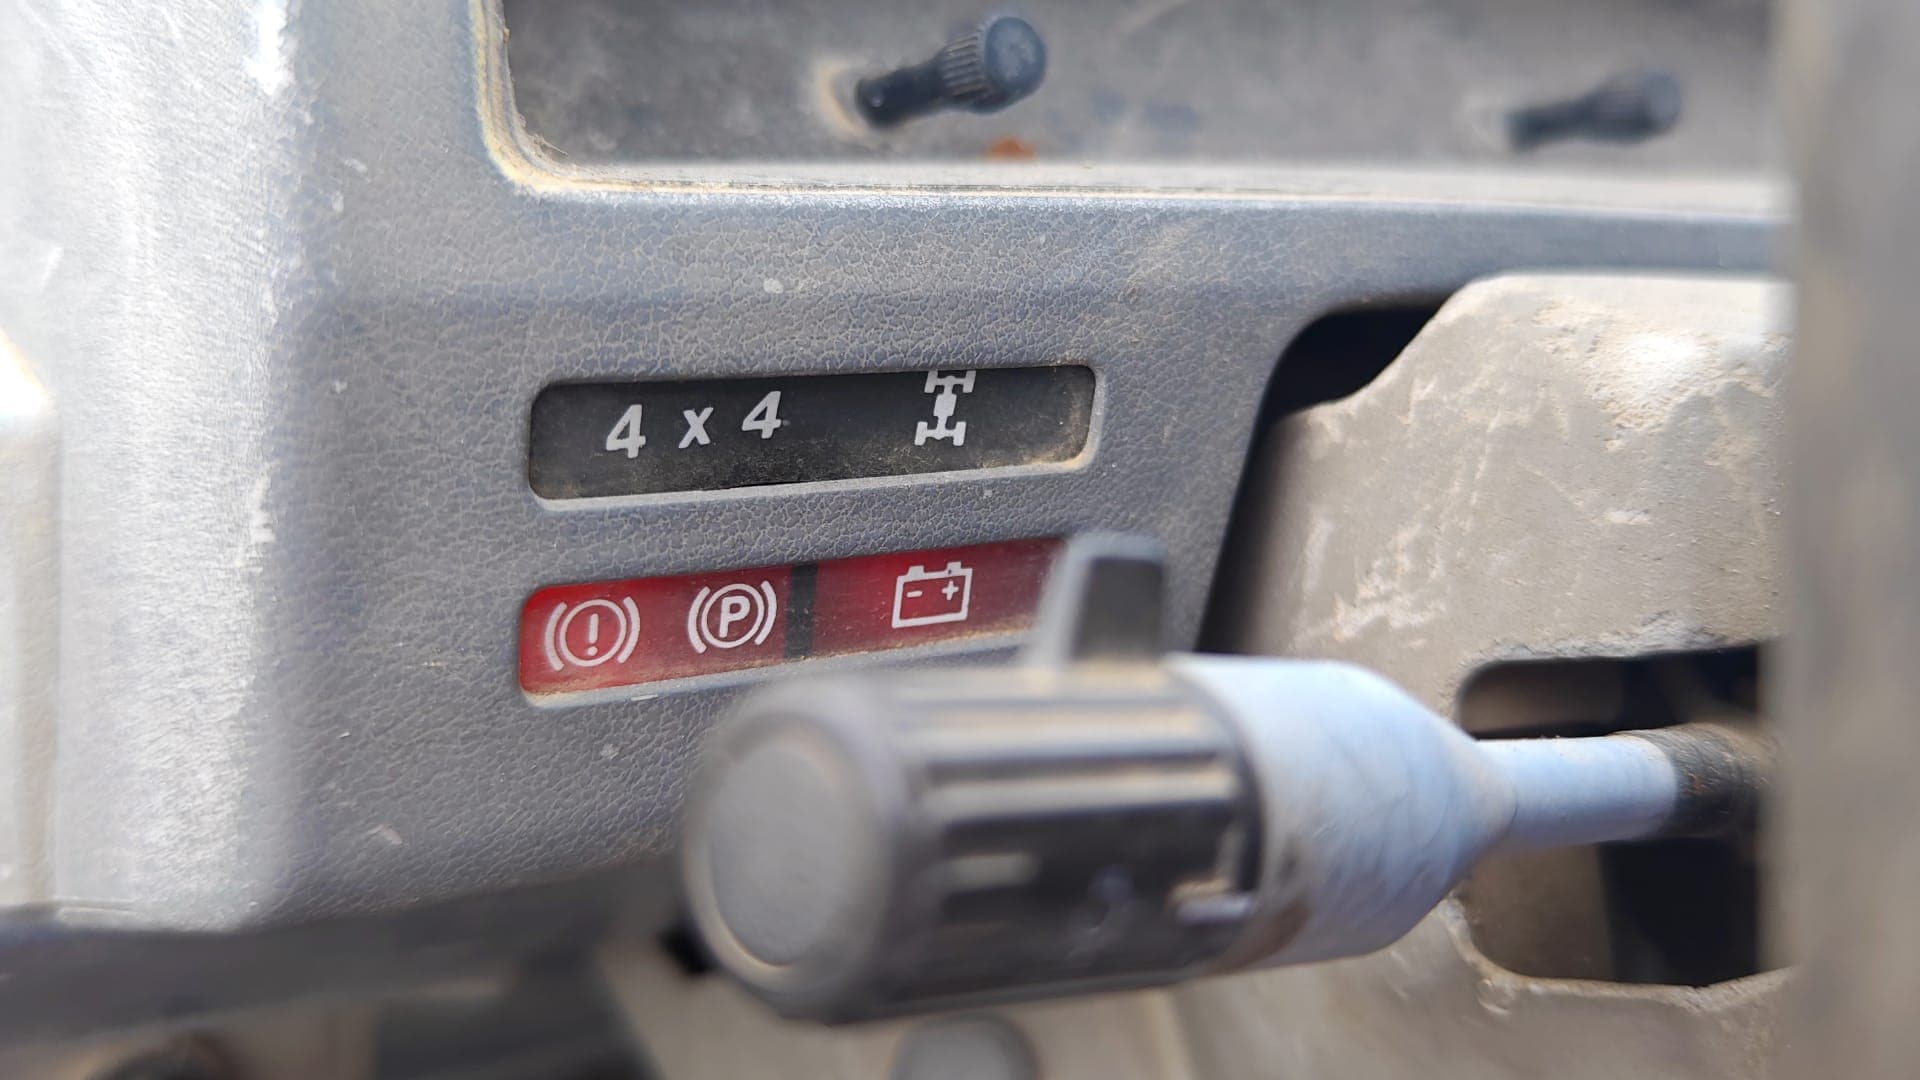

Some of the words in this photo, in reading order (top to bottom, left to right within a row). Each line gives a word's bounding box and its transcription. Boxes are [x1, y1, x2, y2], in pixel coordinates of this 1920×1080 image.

[605, 404, 646, 459] 4
[741, 390, 782, 439] 4
[719, 596, 749, 638] P
